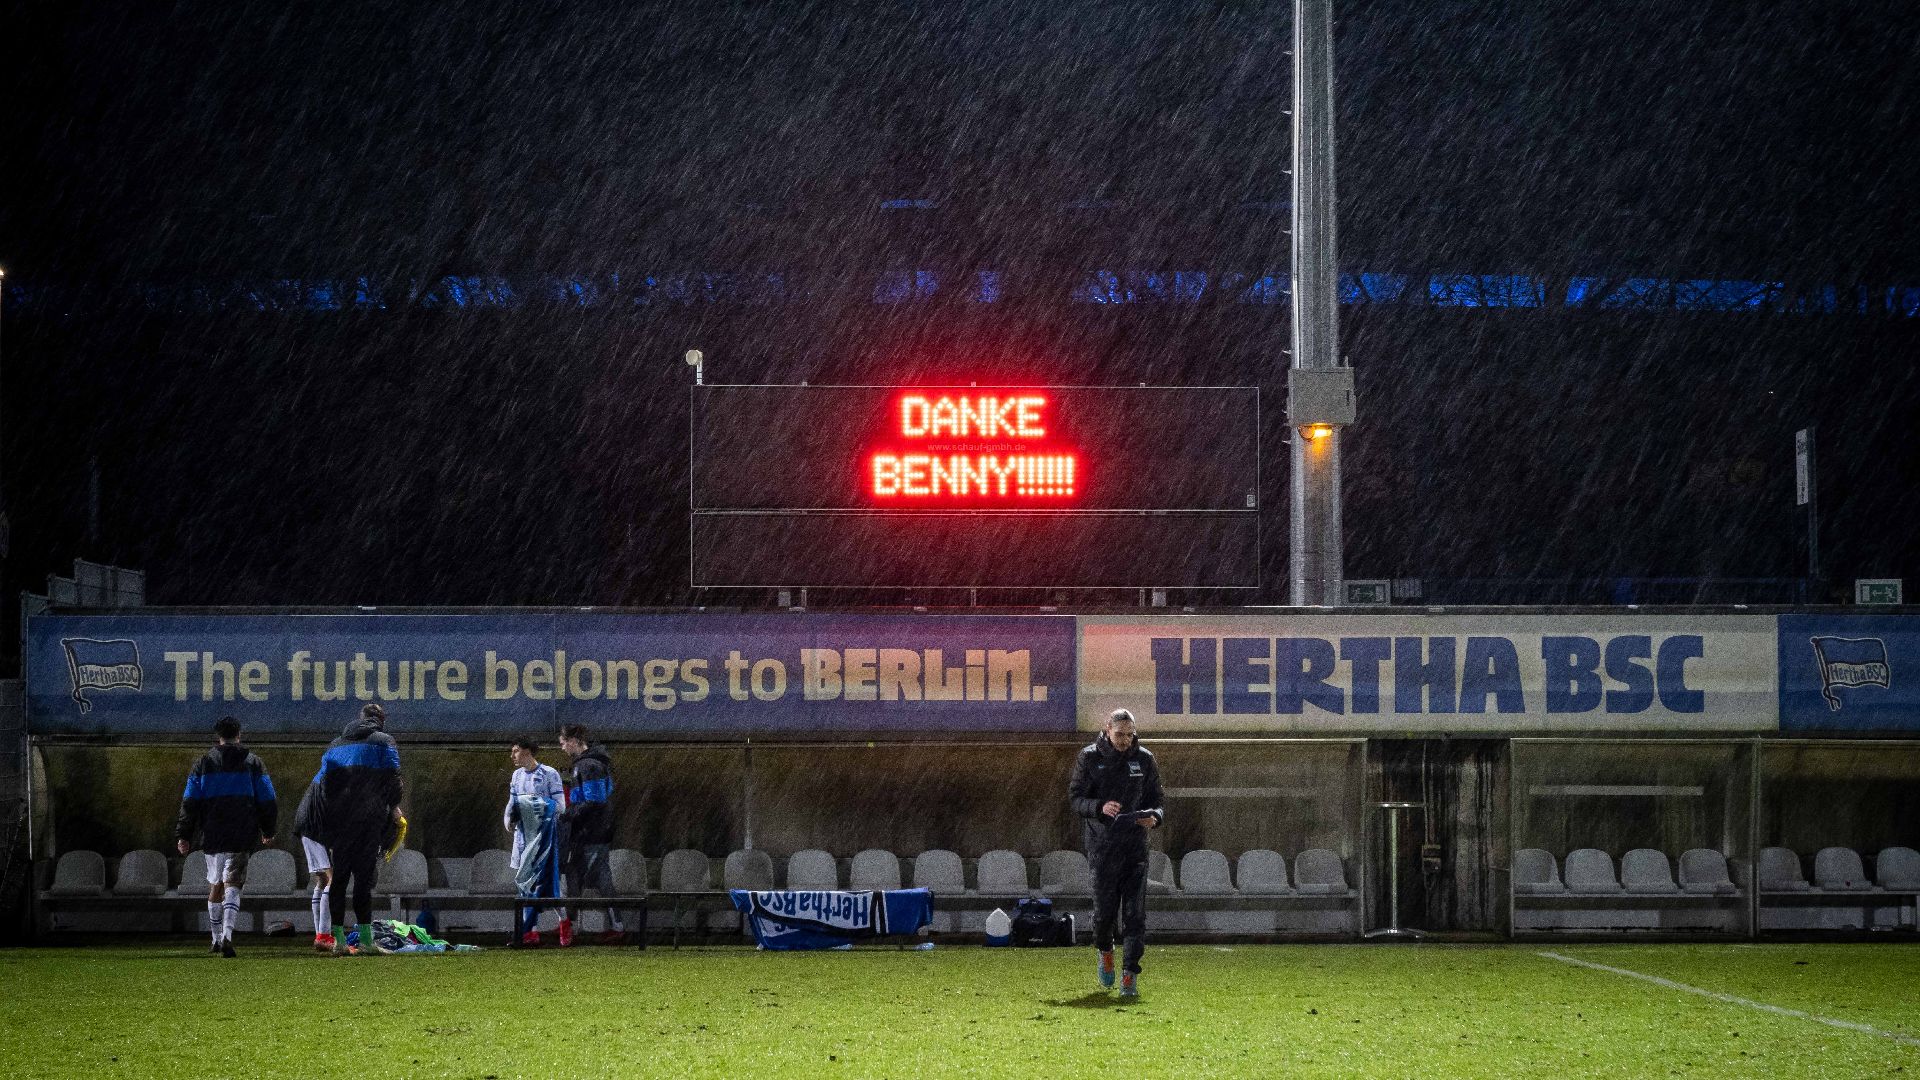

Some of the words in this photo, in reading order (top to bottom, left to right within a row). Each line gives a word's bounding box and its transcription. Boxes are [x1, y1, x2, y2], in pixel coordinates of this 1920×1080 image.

[902, 396, 1045, 436] DANKE
[927, 442, 1026, 453] www.schauf-gmbh.de
[873, 455, 1075, 495] BENNY!!!!!!
[164, 651, 271, 701] The
[287, 650, 467, 701] future
[485, 650, 709, 711] belongs
[725, 650, 787, 701] to
[1150, 635, 1526, 715] HERTHA
[1541, 634, 1705, 714] BSC
